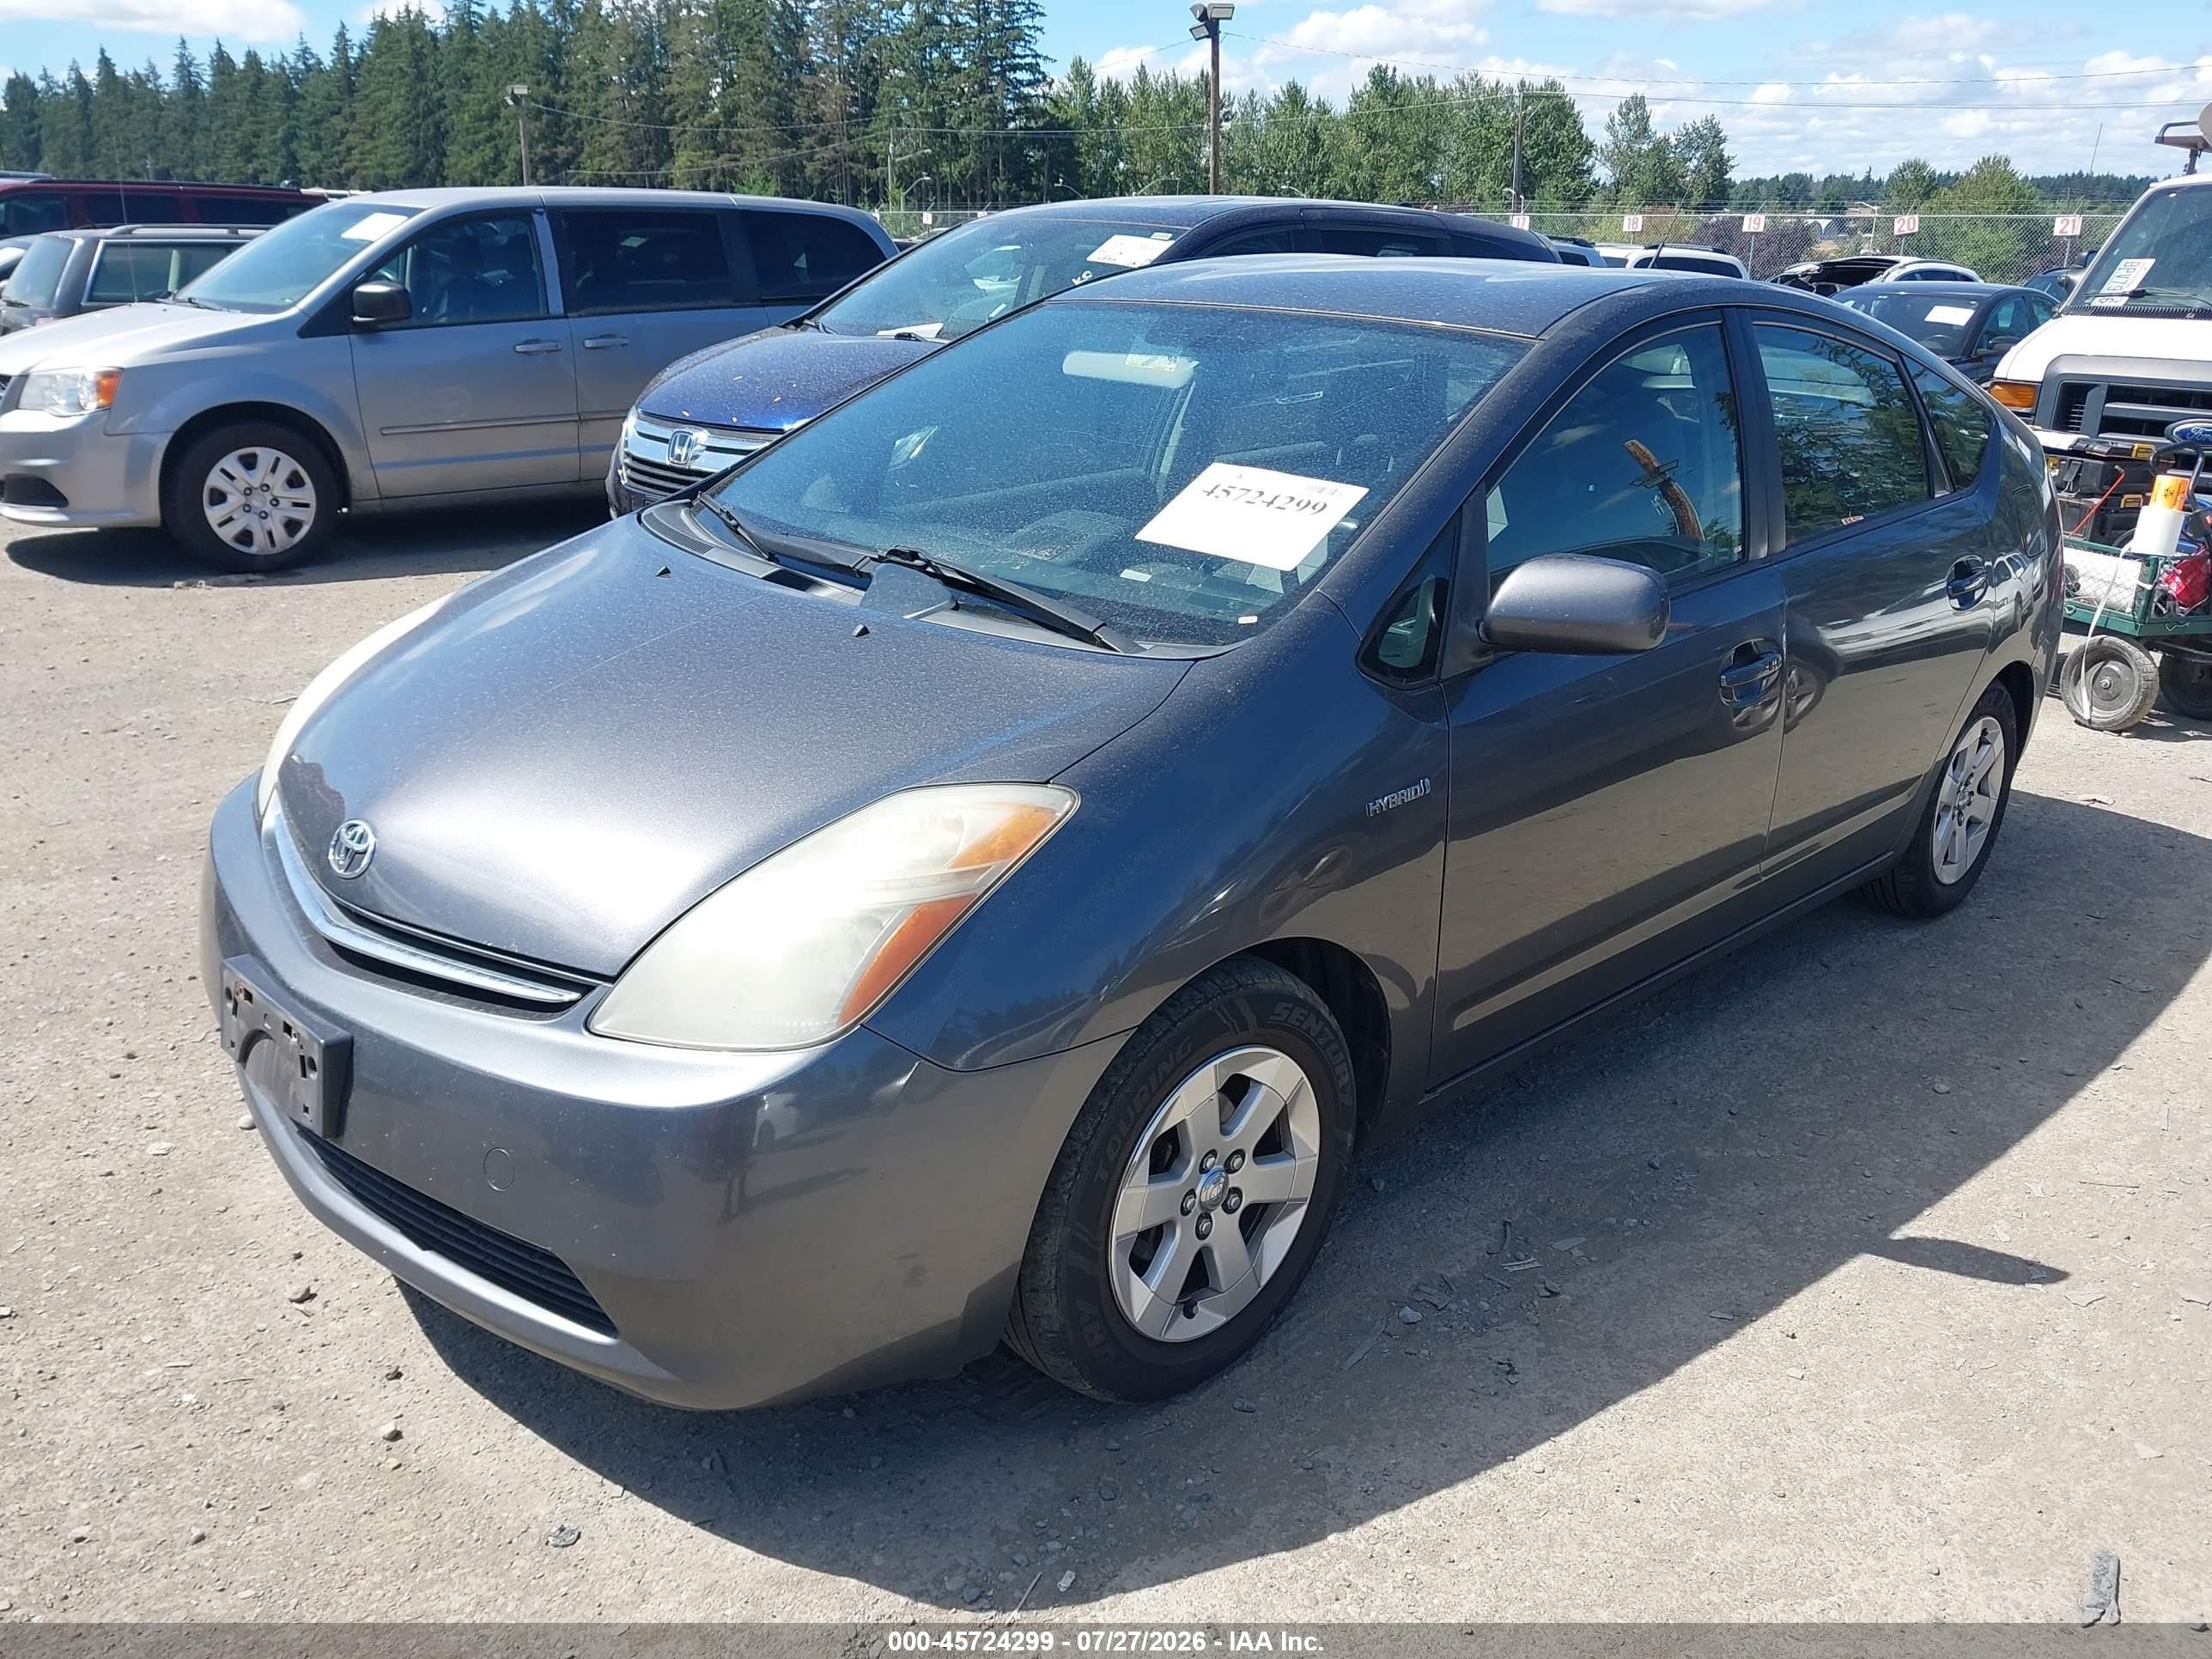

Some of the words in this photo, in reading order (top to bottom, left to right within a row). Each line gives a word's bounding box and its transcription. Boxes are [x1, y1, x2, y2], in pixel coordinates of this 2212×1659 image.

[1516, 216, 1526, 229] 17
[1627, 216, 1639, 230] 18
[1747, 216, 1761, 231] 19
[1896, 216, 1916, 233] 20
[2059, 218, 2076, 234] 21
[2098, 261, 2141, 304] BPV796
[1202, 483, 1328, 516] 45724299
[1366, 782, 1422, 817] HYBRID
[1268, 1001, 1353, 1107] SENTURY
[1093, 1034, 1194, 1184] TOURING
